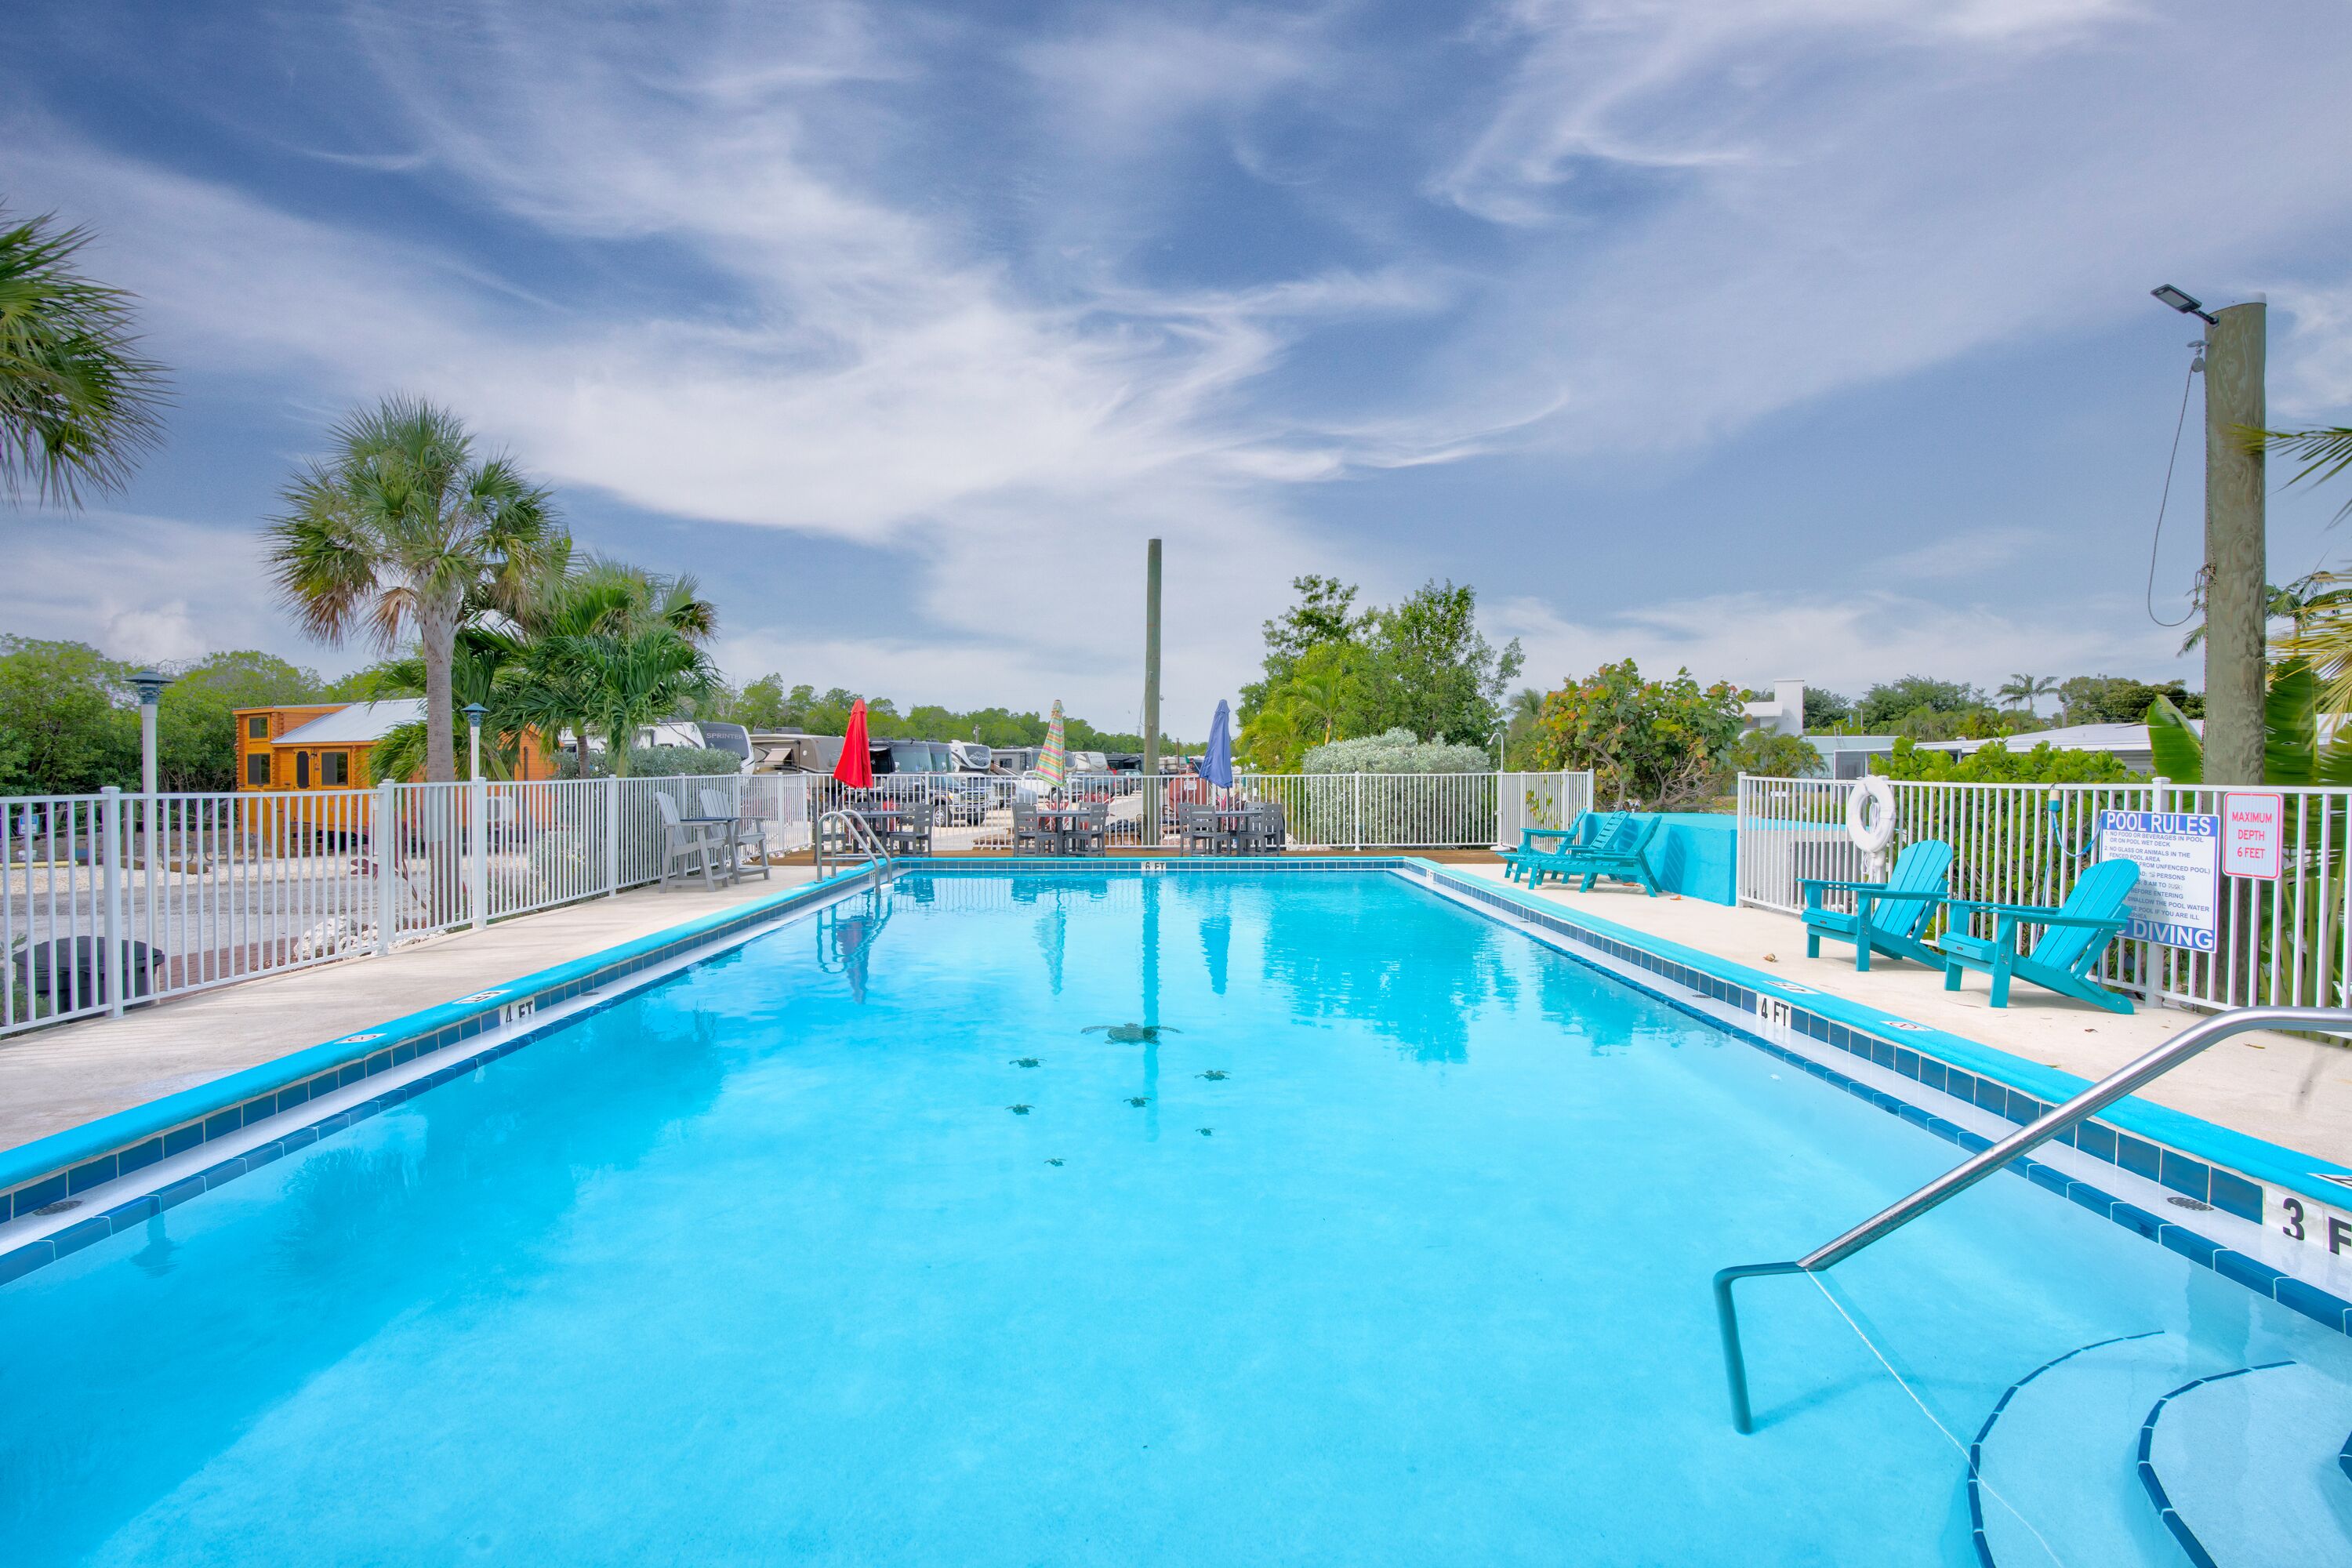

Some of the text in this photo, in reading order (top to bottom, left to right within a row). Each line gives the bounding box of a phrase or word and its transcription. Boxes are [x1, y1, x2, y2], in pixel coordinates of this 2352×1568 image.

[2107, 812, 2211, 836] POOL RULES
[2232, 811, 2272, 823] MAXIMUM
[2238, 829, 2265, 840] DEPTH
[2237, 847, 2266, 859] 6 FEET
[2154, 891, 2183, 899] ENTERING
[2133, 919, 2213, 949] DIVING
[506, 1000, 533, 1023] 4 FT
[1762, 998, 1789, 1026] 4 FT
[2283, 1197, 2352, 1255] 3 F
